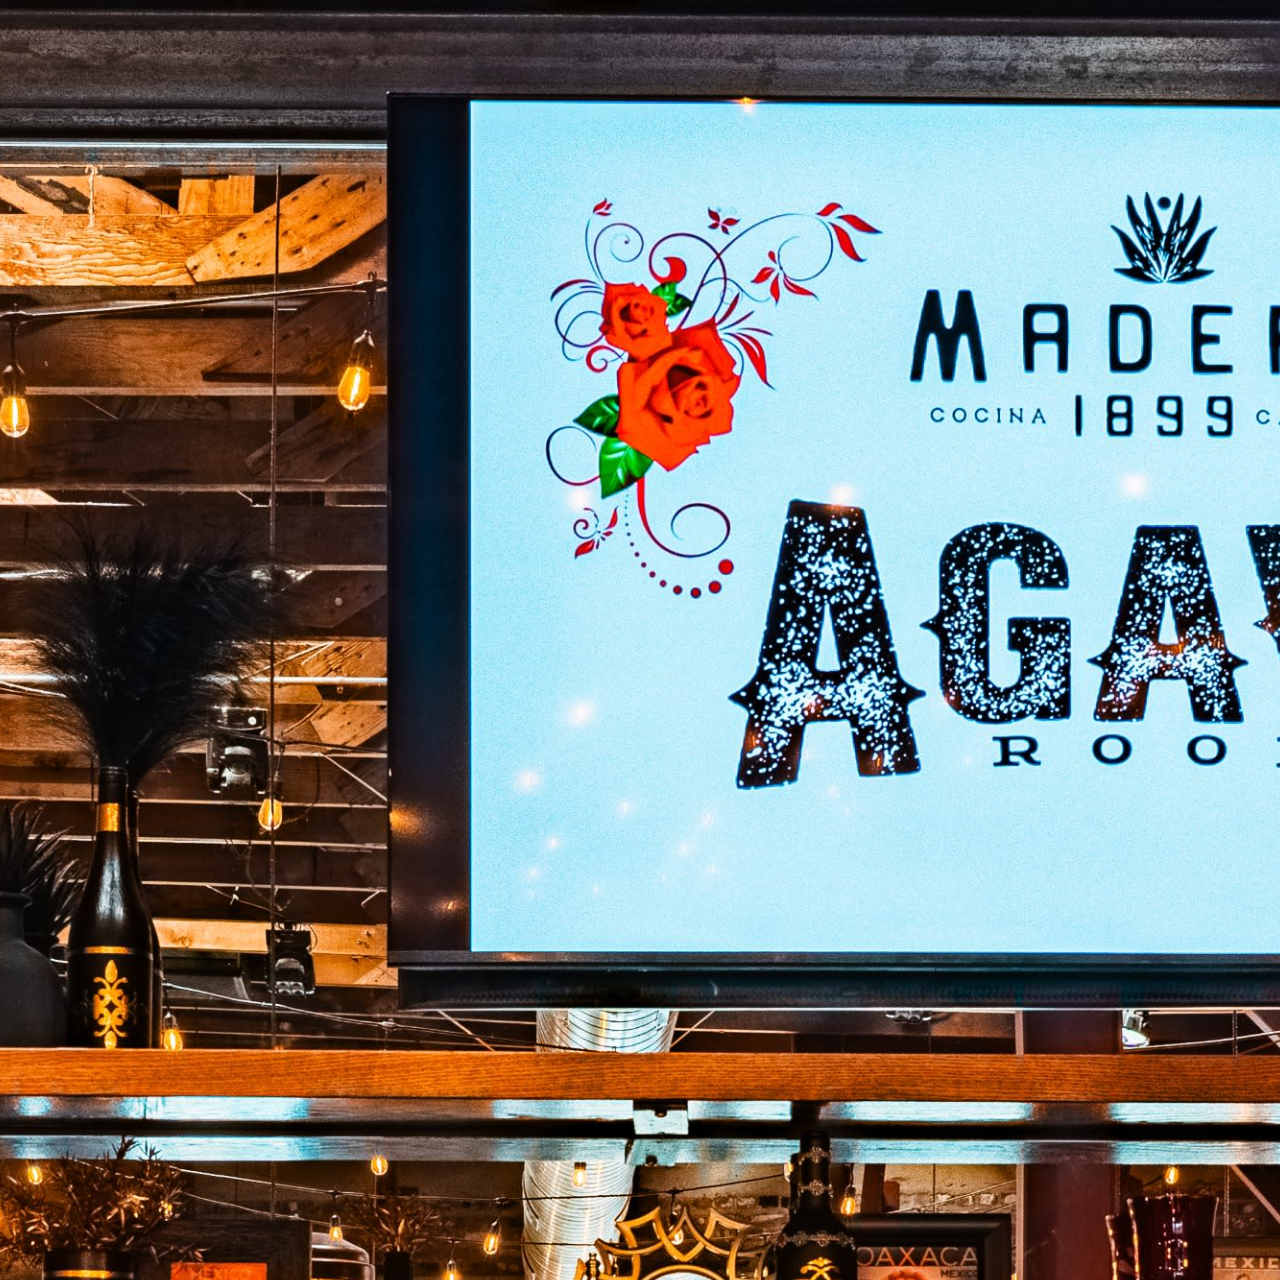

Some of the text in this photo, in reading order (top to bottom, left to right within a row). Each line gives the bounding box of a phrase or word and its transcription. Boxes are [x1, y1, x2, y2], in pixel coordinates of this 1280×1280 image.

[930, 407, 1047, 424] COCINA
[1074, 394, 1234, 437] 1899
[856, 1246, 977, 1267] OAXACA
